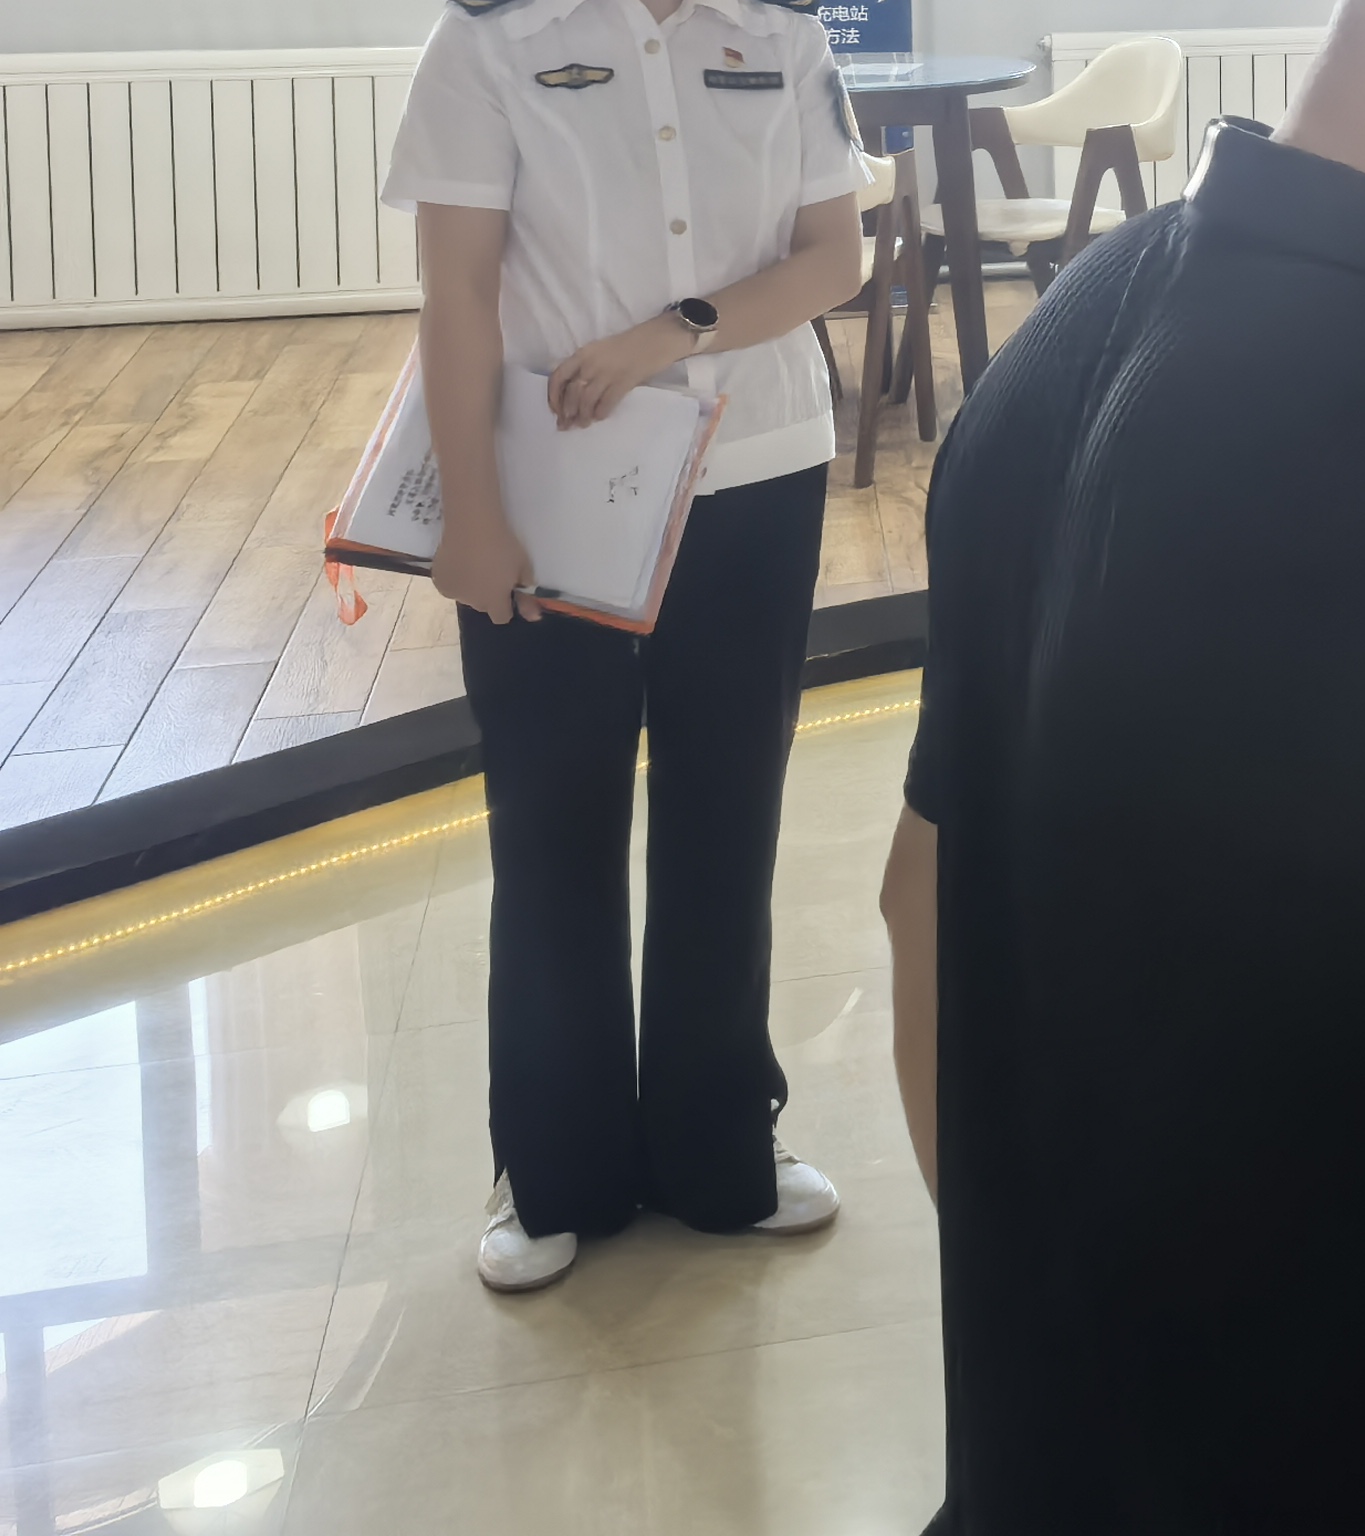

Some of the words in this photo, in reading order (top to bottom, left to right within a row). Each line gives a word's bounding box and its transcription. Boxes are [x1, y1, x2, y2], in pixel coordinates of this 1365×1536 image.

[817, 5, 869, 22] 充电站
[827, 27, 861, 45] 方法
